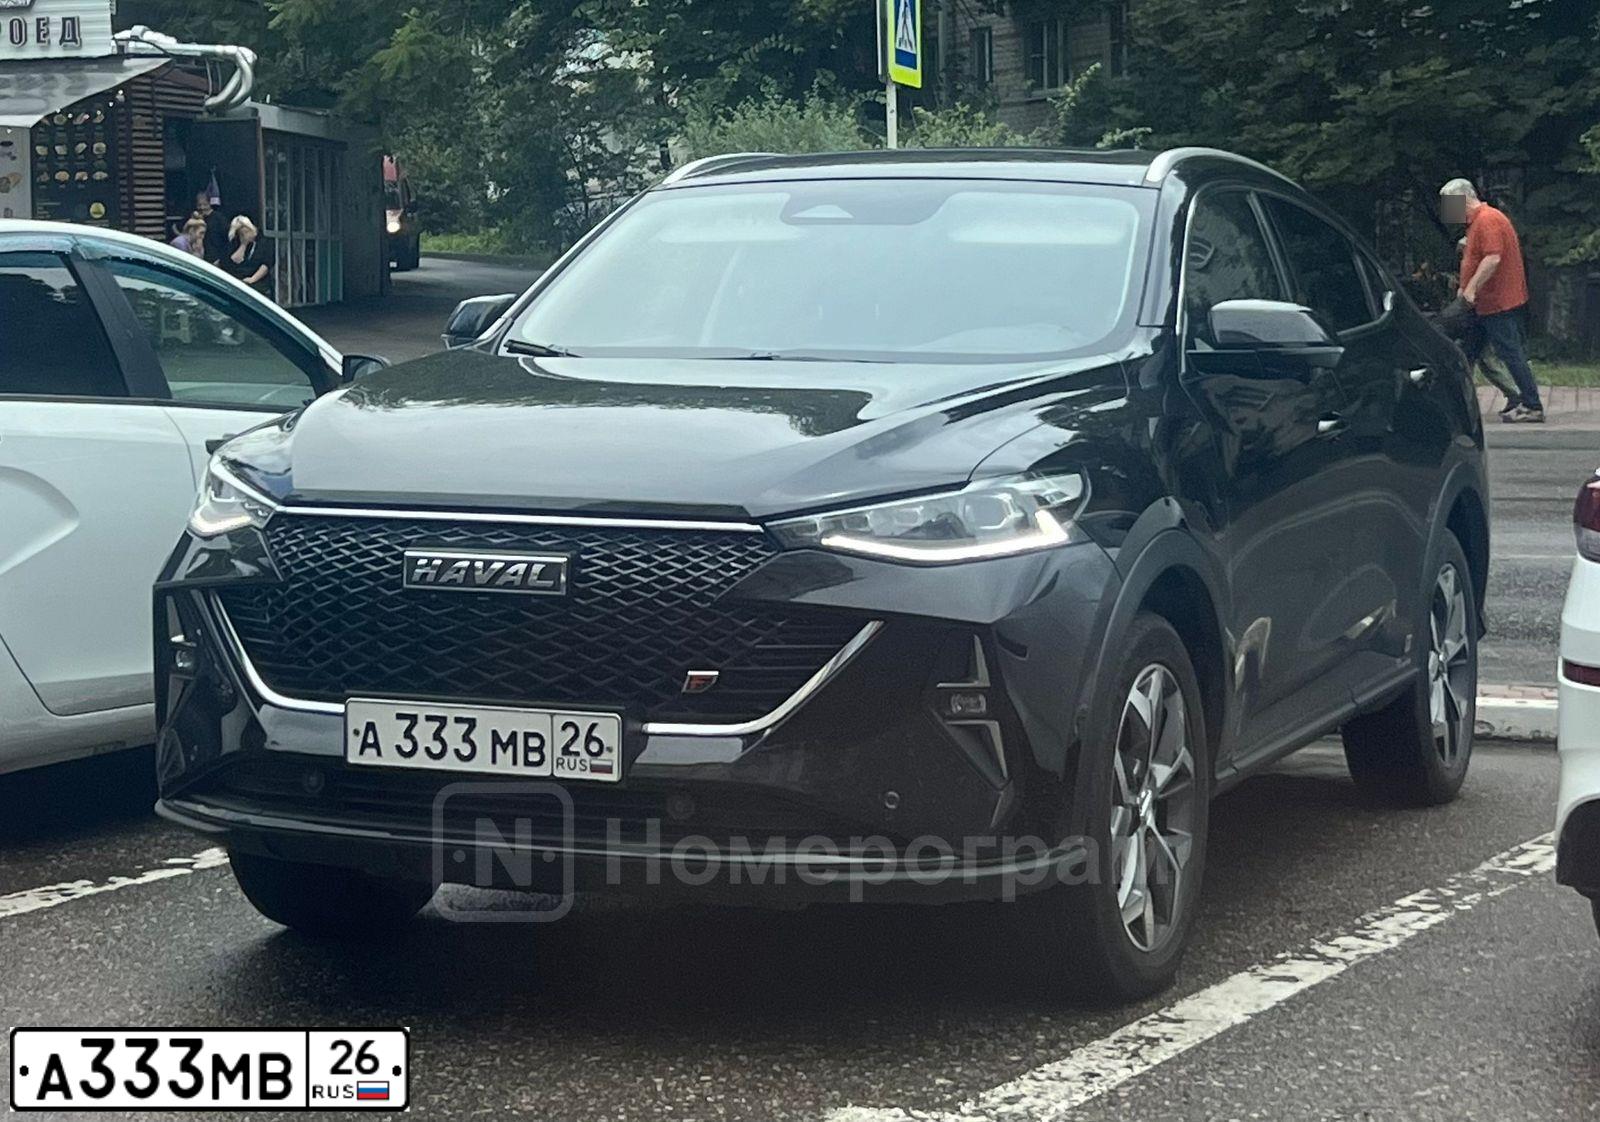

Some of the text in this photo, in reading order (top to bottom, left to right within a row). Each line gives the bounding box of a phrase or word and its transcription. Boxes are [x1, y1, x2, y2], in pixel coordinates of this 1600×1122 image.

[0, 16, 82, 49] ОЕД
[411, 557, 555, 588] HAVAL
[394, 712, 478, 762] 333
[559, 720, 605, 758] 26
[555, 757, 588, 772] RUS
